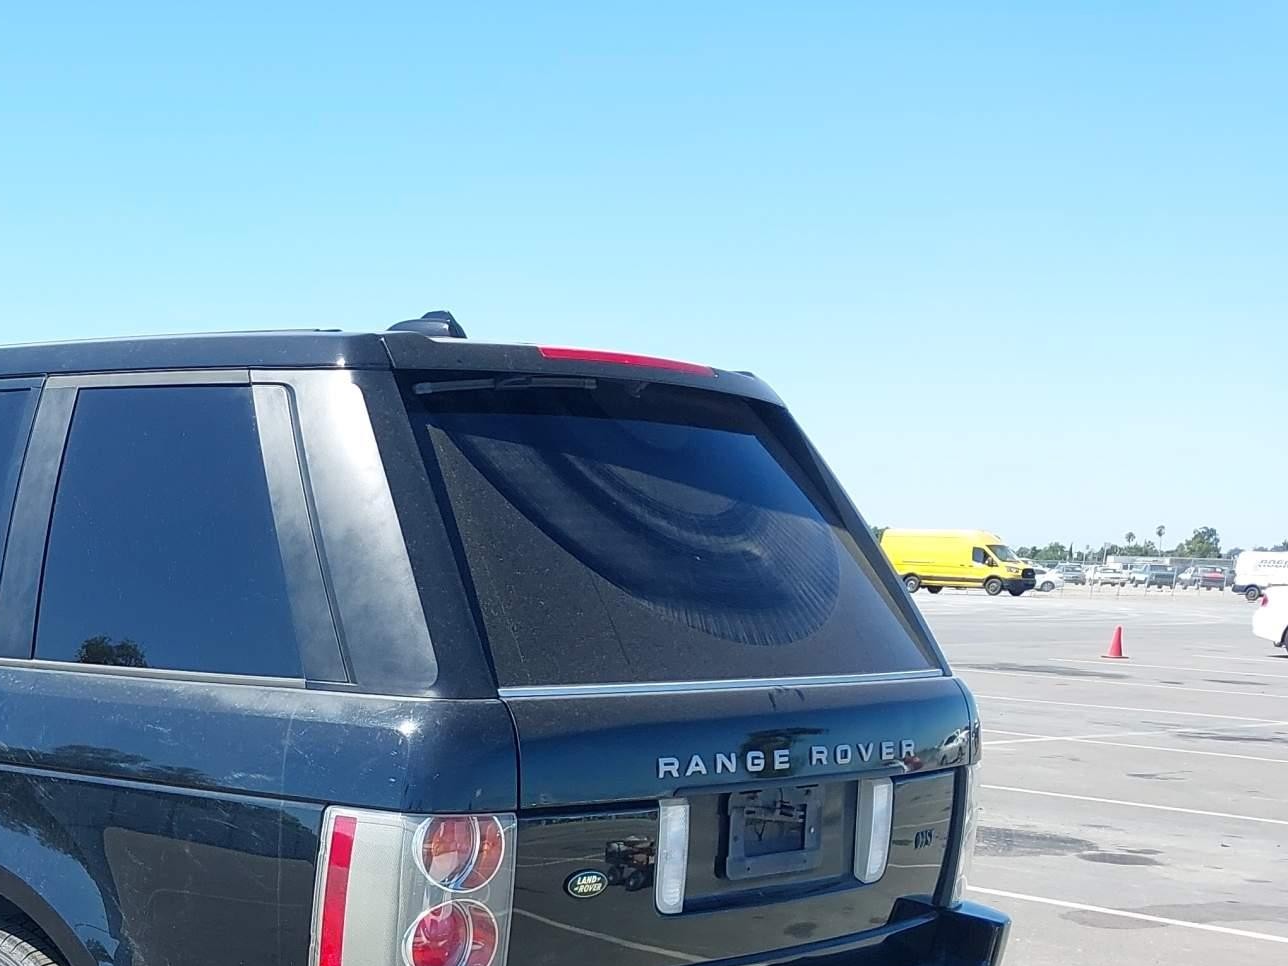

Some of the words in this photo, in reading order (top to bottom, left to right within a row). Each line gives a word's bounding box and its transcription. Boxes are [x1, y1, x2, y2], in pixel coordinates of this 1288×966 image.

[656, 748, 791, 779] RANGE
[810, 739, 916, 767] ROVER
[577, 875, 598, 885] LAND
[578, 883, 603, 893] ROVER
